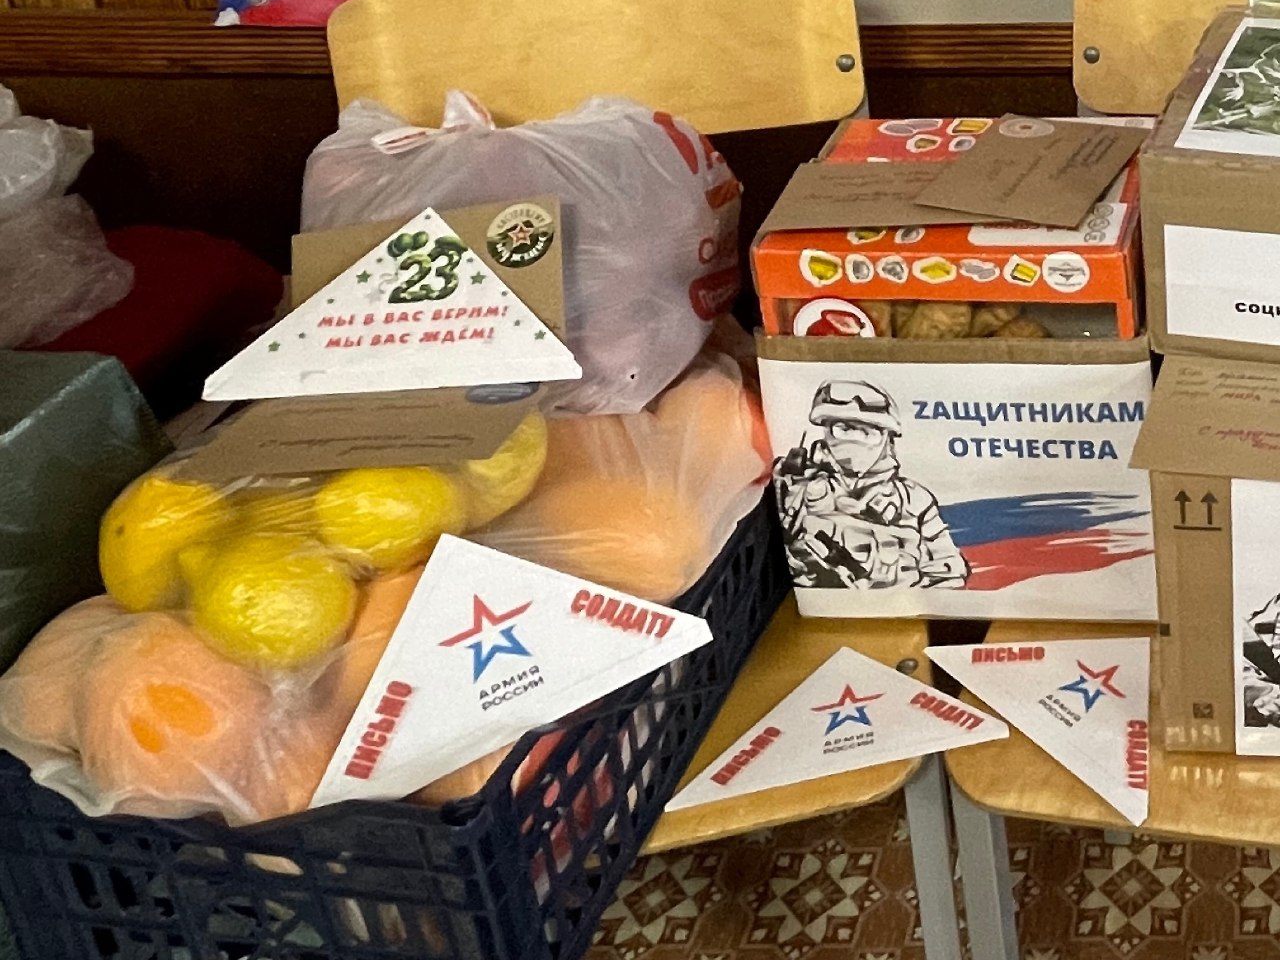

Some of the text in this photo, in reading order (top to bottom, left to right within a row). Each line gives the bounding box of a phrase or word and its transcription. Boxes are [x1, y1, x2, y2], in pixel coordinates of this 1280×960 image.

[317, 304, 510, 328] МЫ В ВАС ВЕРИМ!
[325, 333, 363, 349] МЫ
[370, 331, 412, 346] ВАС
[949, 437, 1119, 460] ОТЕЧЕСТВА
[570, 588, 677, 641] СОЛДАТУ
[971, 646, 1046, 665] ПИСЬМО
[479, 664, 541, 701] АРМИЯ
[481, 675, 546, 712] РОССИИ
[909, 691, 986, 731] СОЛДАТУ
[1037, 698, 1076, 728] РОССИИ
[1044, 693, 1083, 723] АРМИЯ
[343, 679, 416, 781] ПИСЬМО
[823, 731, 875, 746] АРМИЯ
[710, 726, 782, 786] ПИСЬМО
[822, 739, 875, 755] РОССИИ
[1126, 718, 1149, 791] СОЛДАТУ
